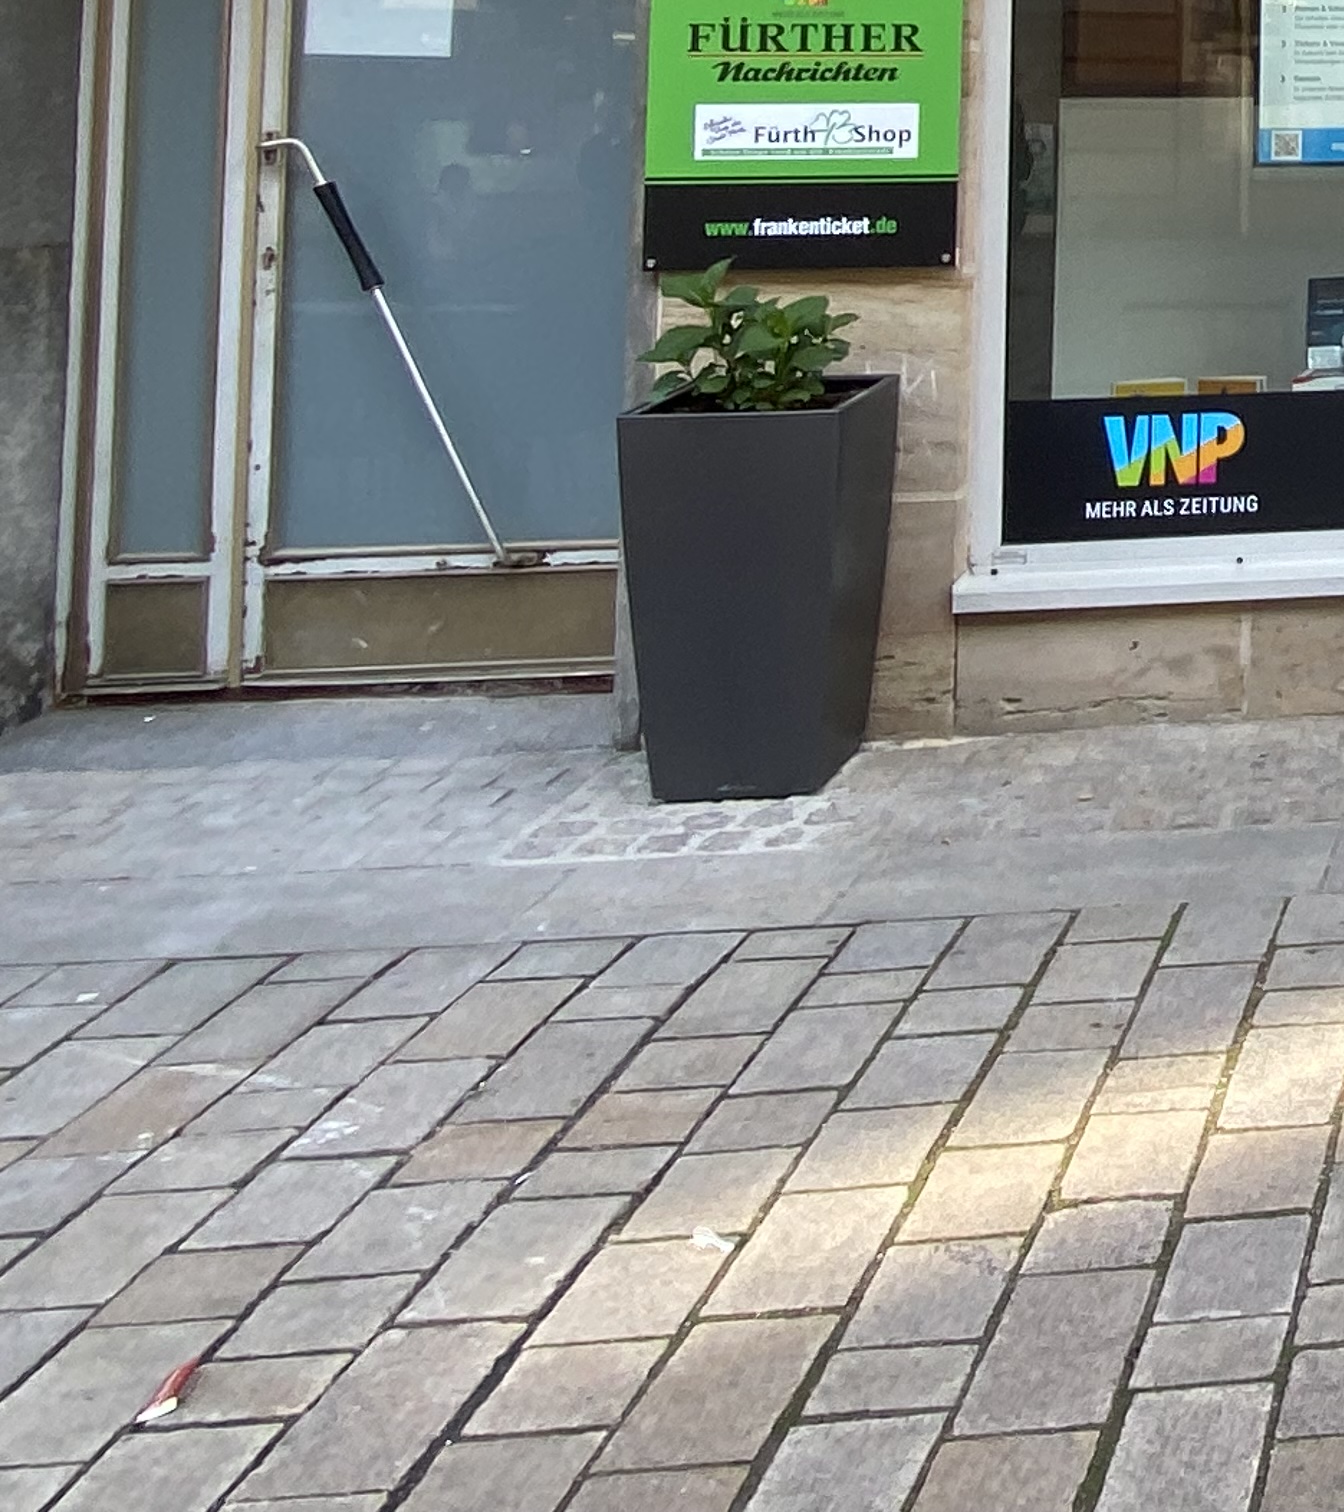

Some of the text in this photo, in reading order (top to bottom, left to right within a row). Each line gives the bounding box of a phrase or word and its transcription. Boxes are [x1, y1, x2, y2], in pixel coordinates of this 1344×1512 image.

[687, 16, 924, 54] FÜRTHER
[711, 60, 900, 84] Nachrichten
[753, 125, 816, 144] Fürth
[853, 124, 912, 148] Shop
[704, 216, 898, 237] www.frankenticket.de
[1103, 411, 1246, 488] VNP
[1085, 494, 1259, 520] MEHR ALS ZEITUNG
